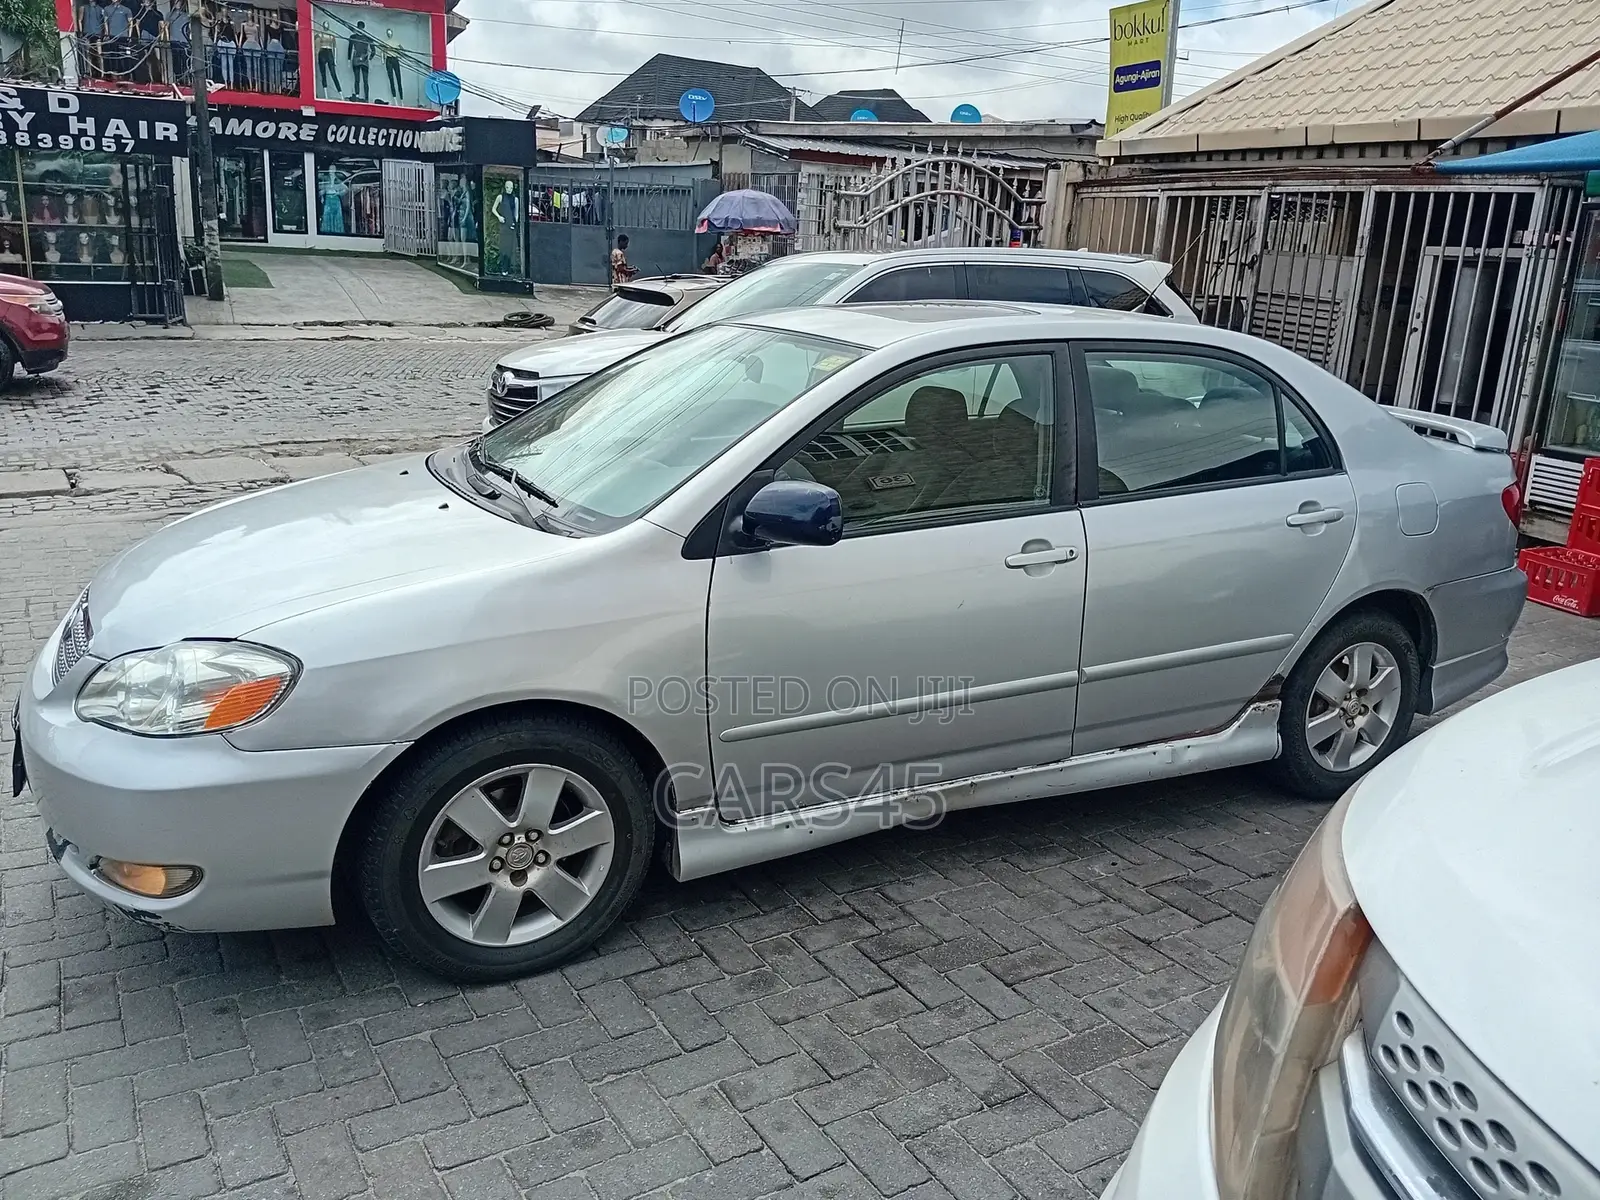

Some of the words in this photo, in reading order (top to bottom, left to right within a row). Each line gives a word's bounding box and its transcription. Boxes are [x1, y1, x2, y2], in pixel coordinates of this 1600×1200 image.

[1128, 37, 1149, 46] MART
[47, 91, 80, 114] D
[0, 111, 36, 131] Y
[69, 115, 179, 142] HAIR
